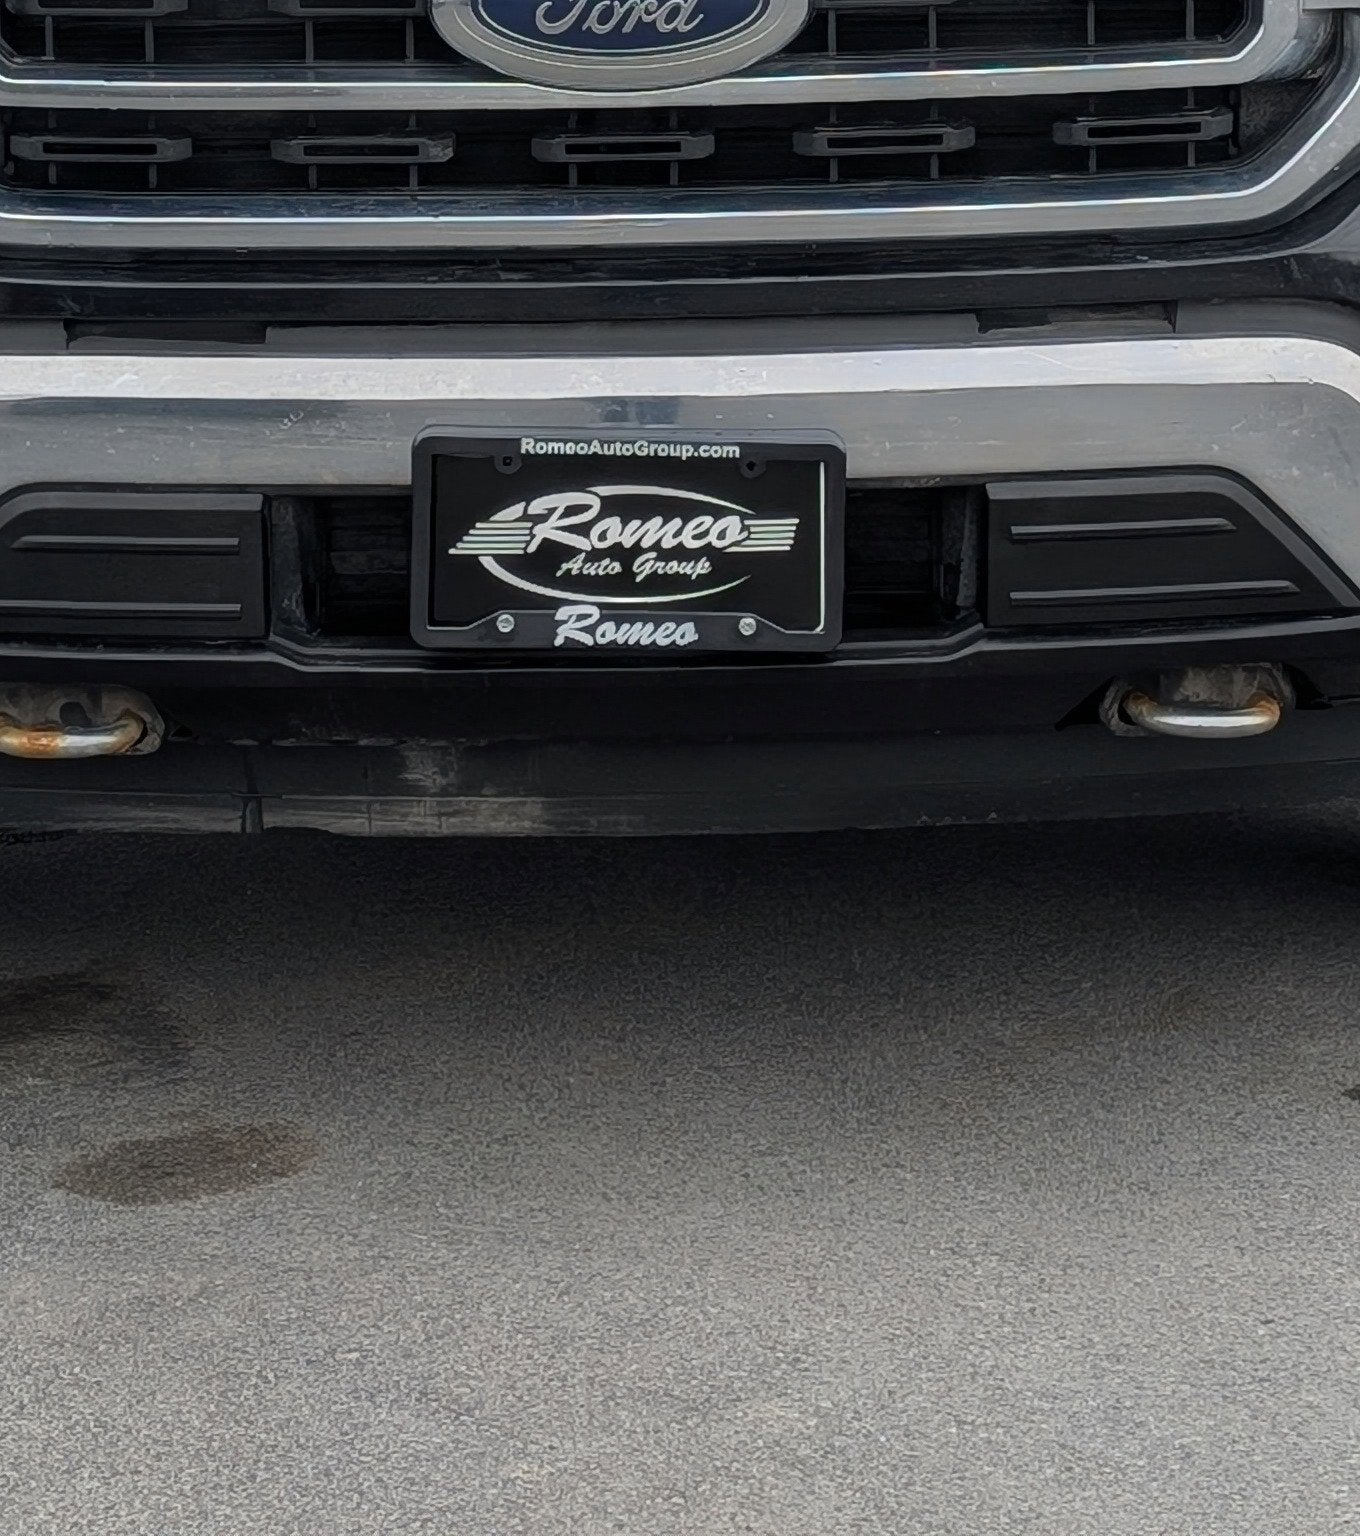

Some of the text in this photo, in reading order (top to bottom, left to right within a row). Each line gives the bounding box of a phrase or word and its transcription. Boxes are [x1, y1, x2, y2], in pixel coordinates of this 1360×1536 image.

[519, 436, 740, 461] RomeoAutoGroup.com
[527, 491, 749, 554] Romeo
[556, 552, 713, 582] Auto Group
[553, 604, 700, 648] Romeo
